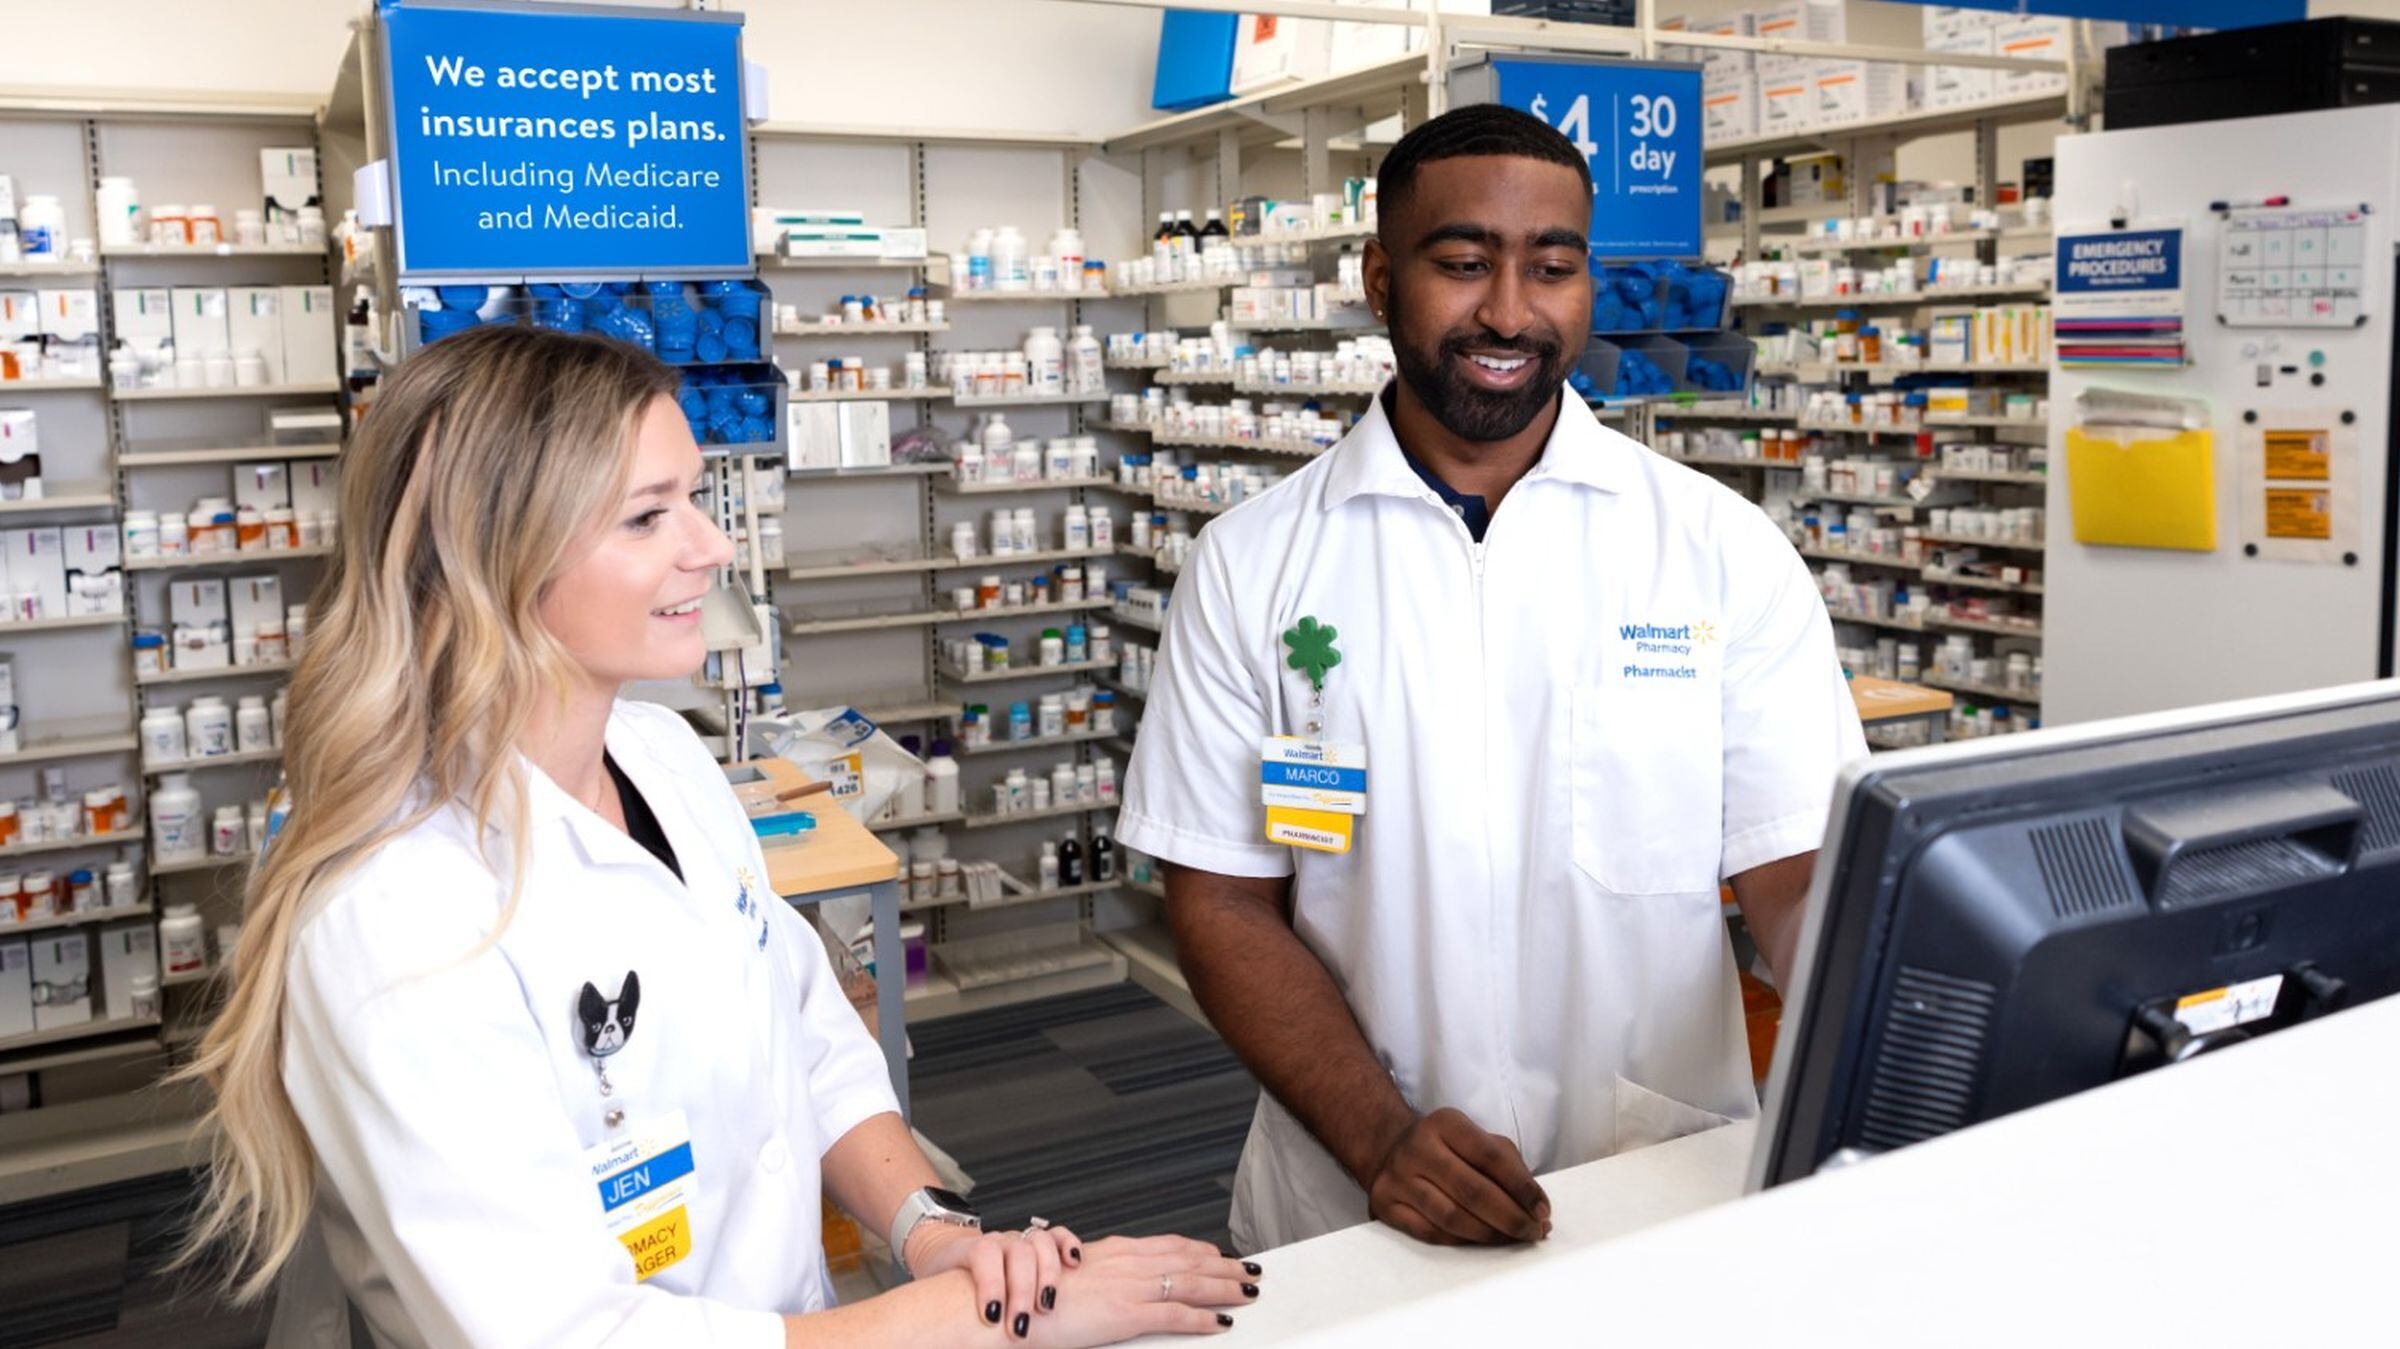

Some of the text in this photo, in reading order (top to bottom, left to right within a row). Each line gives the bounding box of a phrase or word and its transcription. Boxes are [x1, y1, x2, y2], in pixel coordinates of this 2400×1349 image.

[425, 54, 717, 99] We accept most
[421, 106, 727, 148] insurances plans.
[1629, 94, 1678, 138] 30
[1629, 141, 1676, 180] day
[433, 159, 721, 194] Including Medicare
[1629, 184, 1679, 195] prescription
[478, 203, 685, 230] and Medicaid.
[2072, 238, 2165, 260] EMERGENCY
[2068, 257, 2167, 277] PROCEDURES
[1619, 623, 1690, 640] Walmart
[1636, 642, 1691, 655] Pharmacy
[1623, 664, 1697, 679] Pharmacist
[1284, 749, 1323, 760] Walmart
[1286, 767, 1340, 785] MARCO
[607, 1165, 651, 1204] JEN
